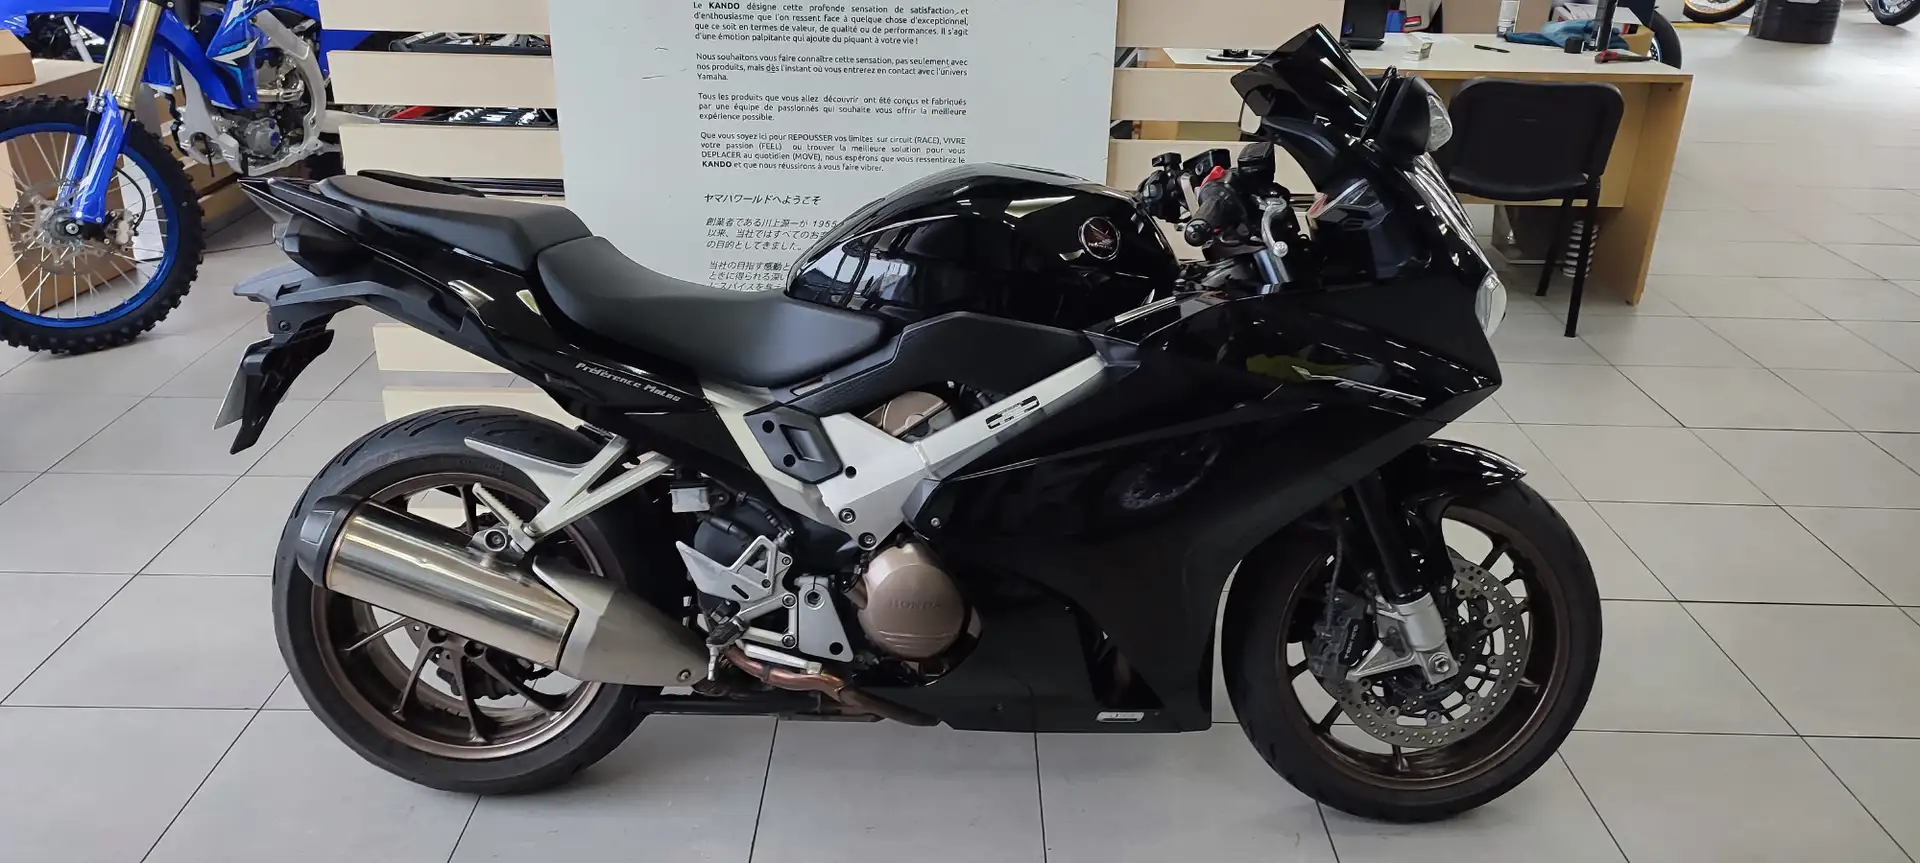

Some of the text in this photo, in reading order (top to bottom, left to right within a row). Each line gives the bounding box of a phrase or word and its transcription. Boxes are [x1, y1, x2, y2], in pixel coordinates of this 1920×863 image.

[708, 2, 740, 10] KANDO
[746, 2, 777, 12] désigne
[782, 3, 803, 11] cette
[809, 4, 846, 14] profonde
[851, 4, 888, 12] sensation
[894, 5, 904, 13] de
[960, 6, 969, 14] et
[694, 12, 754, 21] d'enthousiasme
[757, 15, 772, 23] que
[775, 14, 790, 22] l'on
[792, 14, 821, 22] ressent
[850, 15, 882, 25] quelque
[885, 16, 908, 24] chose
[694, 24, 709, 32] que
[750, 23, 778, 31] termes
[791, 24, 817, 34] valeur,
[819, 24, 829, 32] de
[830, 24, 858, 34] qualité
[872, 25, 882, 33] de
[948, 27, 968, 36] s'agit
[694, 32, 717, 40] d'une
[718, 33, 750, 41] émotion
[752, 34, 791, 43] palpitante
[792, 34, 805, 44] qui
[806, 34, 830, 44] ajoute
[832, 35, 842, 43] du
[844, 35, 873, 45] piquant
[880, 36, 902, 44] votre
[902, 36, 914, 44] vie
[696, 52, 716, 60] Nous
[717, 53, 758, 61] souhaitons
[778, 54, 796, 62] faire
[797, 55, 834, 63] connaître
[856, 56, 894, 66] sensation,
[895, 58, 909, 66] pas
[909, 57, 950, 65] seulement
[712, 63, 746, 73] produits,
[747, 64, 765, 72] mais
[766, 64, 780, 72] dès
[780, 64, 812, 72] l'instant
[843, 66, 876, 74] entrerez
[888, 66, 916, 74] contact
[936, 67, 968, 75] l'univers
[697, 72, 728, 80] Yamaha.
[698, 92, 716, 100] Tous
[731, 93, 763, 103] produits
[764, 95, 780, 103] que
[823, 95, 859, 103] découvrir
[863, 96, 876, 104] ont
[878, 96, 892, 104] été
[893, 97, 919, 106] conçus
[921, 97, 929, 105] et
[931, 98, 967, 108] fabriqués
[698, 104, 712, 112] par
[734, 103, 760, 113] équipe
[778, 104, 819, 114] passionnés
[823, 105, 835, 114] qui
[838, 105, 871, 113] souhaite
[920, 107, 927, 115] la
[931, 107, 966, 116] meilleure
[699, 112, 774, 123] expérience possible.
[736, 134, 758, 142] soyez
[768, 134, 787, 142] pour
[788, 133, 833, 142] REPOUSSER
[848, 134, 873, 142] limites
[890, 135, 913, 143] circuit
[914, 136, 942, 146] (RACE),
[943, 136, 966, 144] VIVRE
[726, 142, 754, 152] passion
[758, 143, 782, 152] (FEEL)
[807, 144, 835, 152] trouver
[839, 144, 846, 152] la
[851, 144, 886, 153] meilleure
[891, 145, 921, 153] solution
[926, 147, 944, 156] pour
[701, 150, 742, 159] DEPLACER
[754, 152, 790, 162] quotidien
[792, 152, 822, 162] (MOVE),
[844, 154, 878, 164] espérons
[880, 156, 894, 164] que
[916, 155, 956, 164] ressentirez
[958, 156, 965, 164] le
[702, 160, 732, 168] KANDO
[743, 162, 758, 170] que
[778, 162, 816, 170] réussirons
[842, 163, 859, 171] faire
[860, 163, 884, 171] vibrer.
[704, 193, 821, 205] ヤマハワールドへようこそ
[576, 362, 642, 389] Préférence
[889, 598, 941, 610] HONDA
